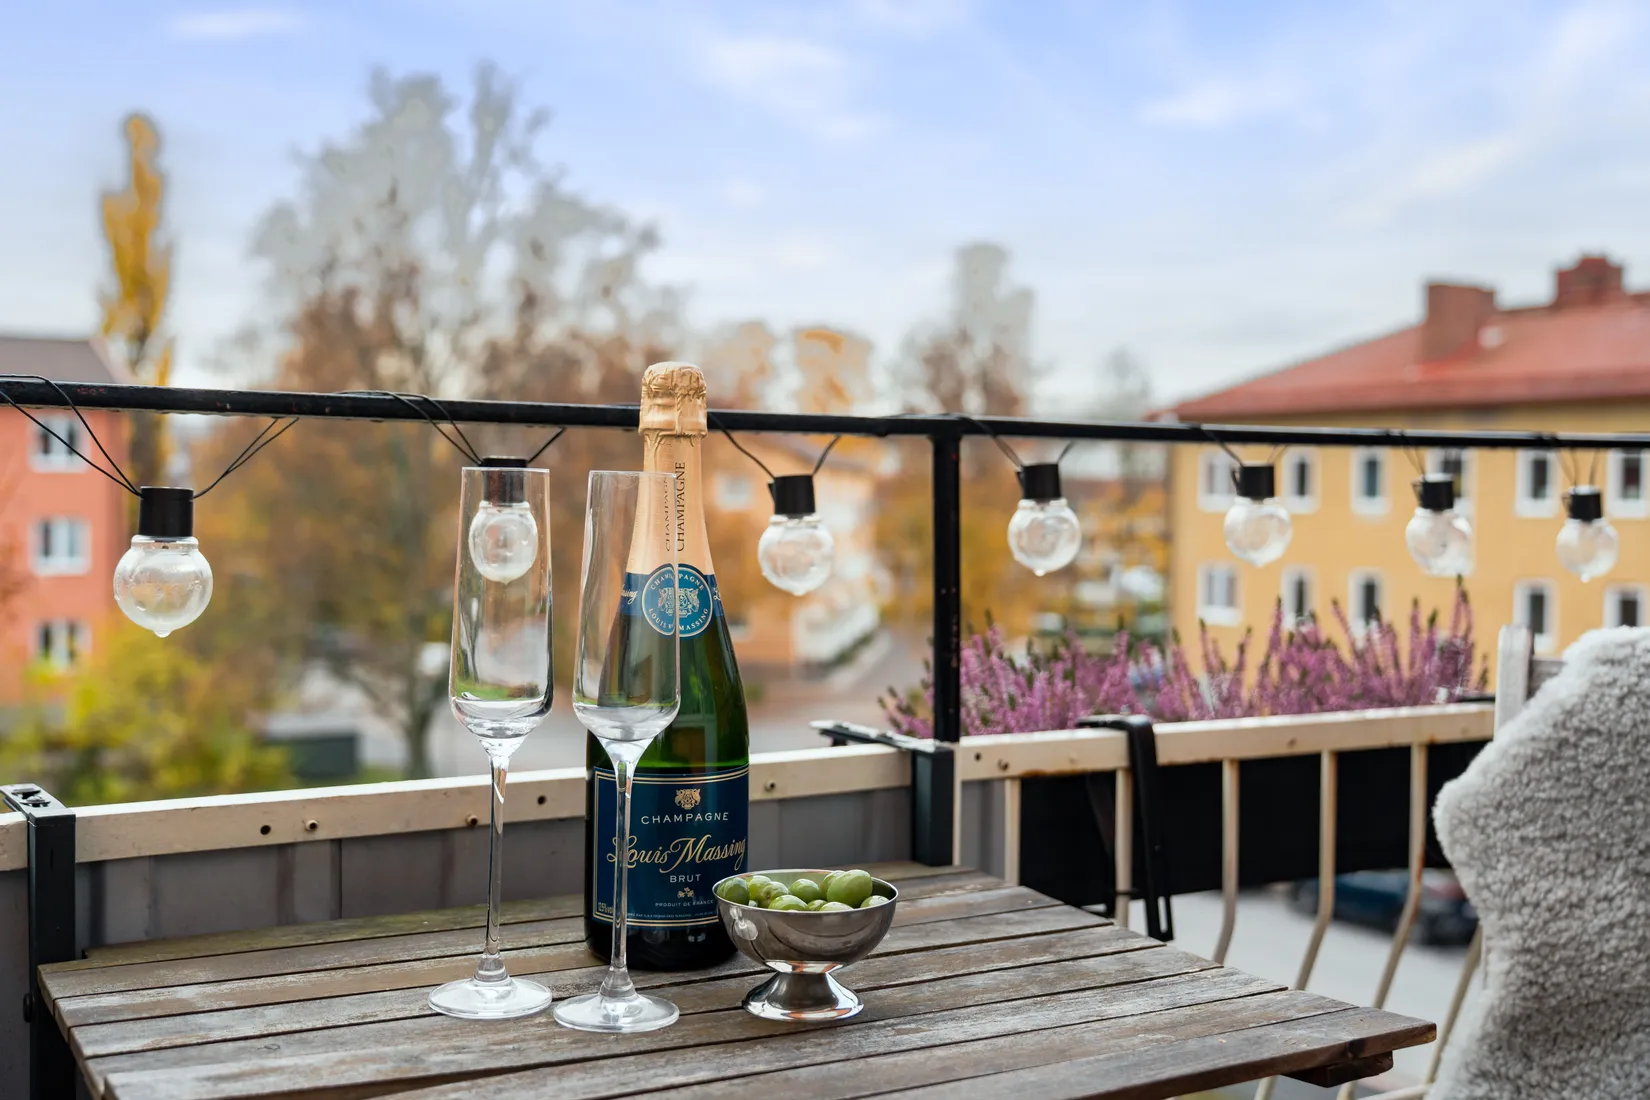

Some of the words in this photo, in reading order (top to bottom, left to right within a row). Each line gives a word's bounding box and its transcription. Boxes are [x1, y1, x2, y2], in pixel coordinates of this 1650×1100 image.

[674, 462, 685, 552] CHAMPAGNE
[648, 607, 667, 629] LOUIS
[678, 608, 709, 631] MASSING
[640, 812, 729, 825] CHAMPAGNE
[606, 835, 671, 869] Louis
[659, 834, 747, 874] Massing
[669, 873, 702, 883] BRUT
